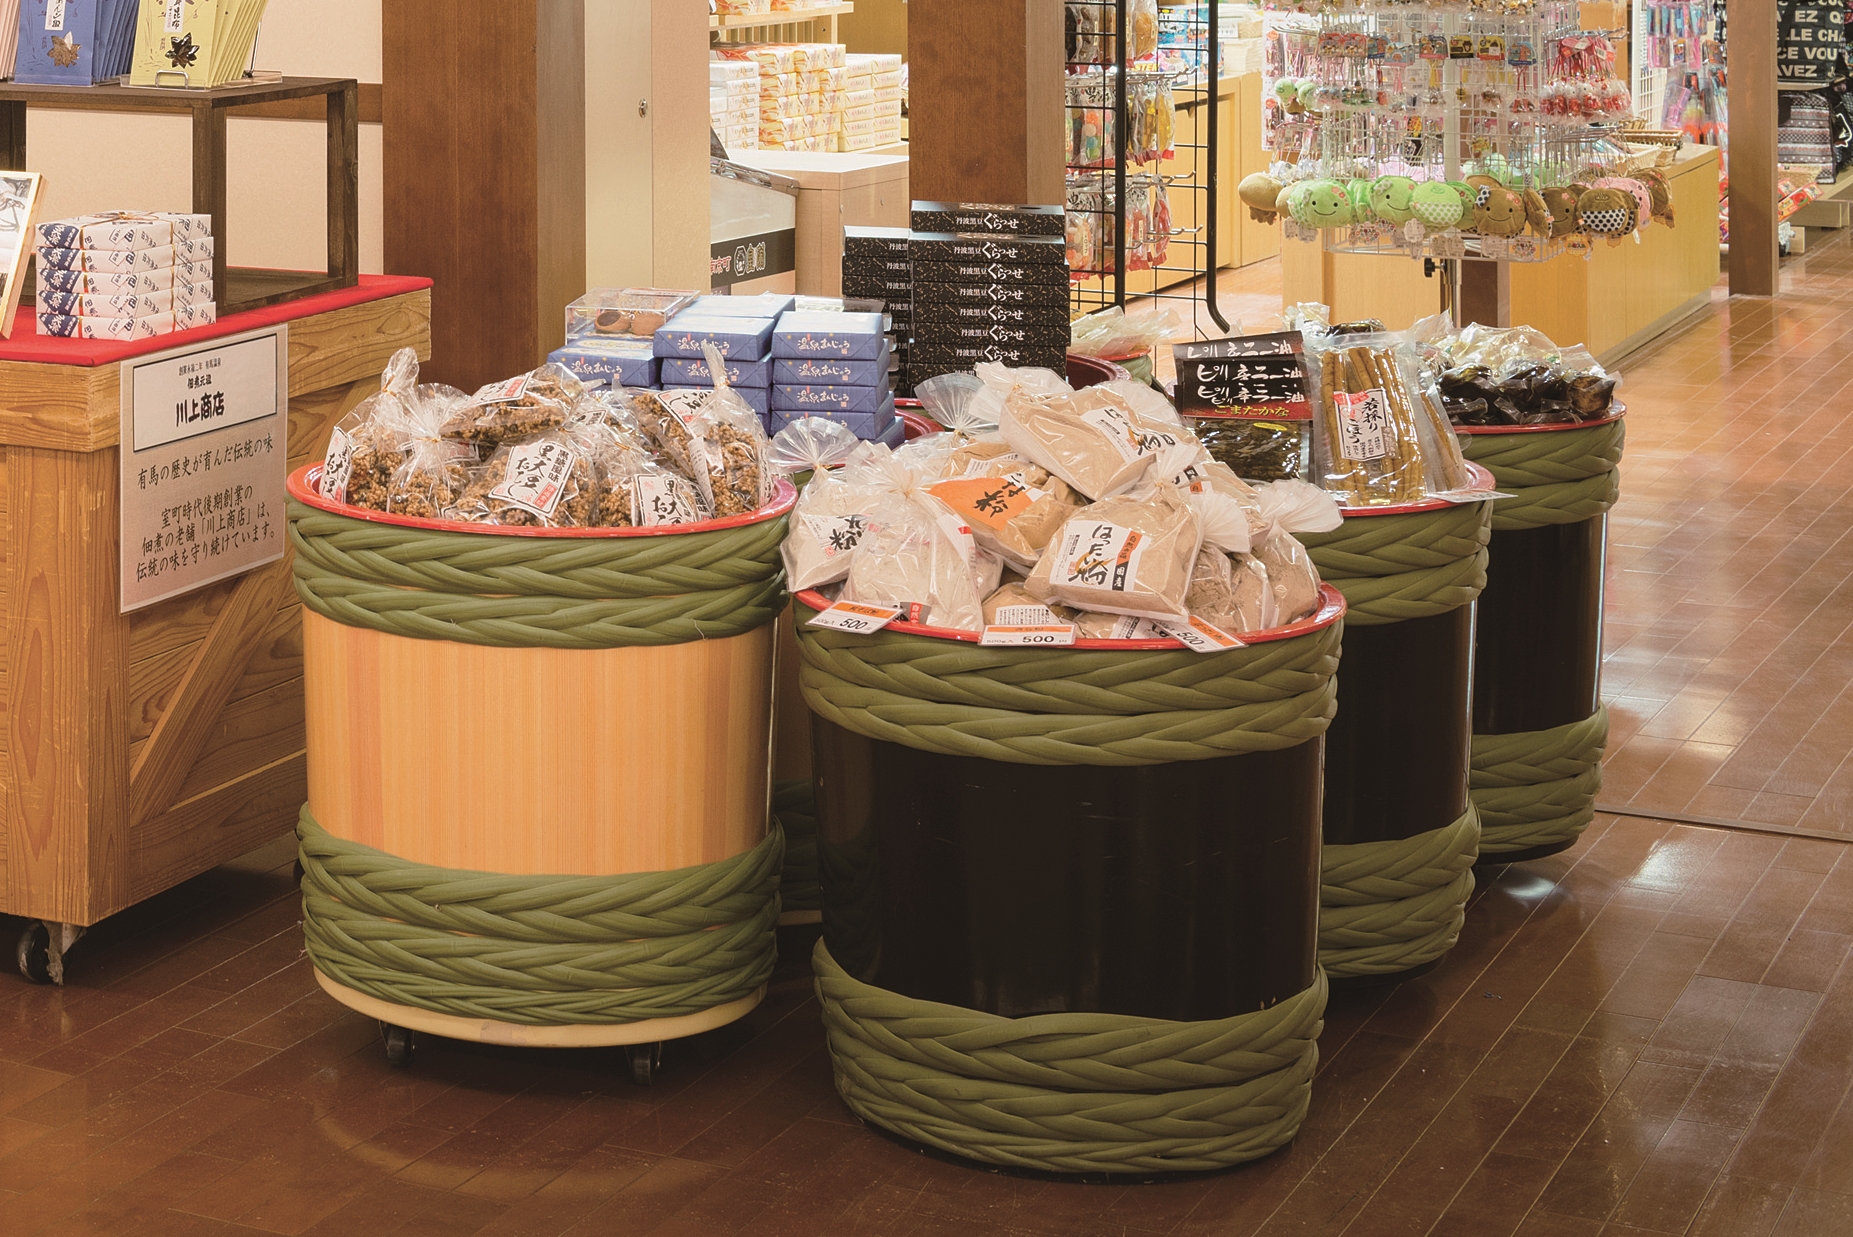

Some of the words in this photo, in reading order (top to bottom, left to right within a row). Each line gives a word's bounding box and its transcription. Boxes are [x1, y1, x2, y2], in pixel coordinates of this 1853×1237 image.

[175, 391, 225, 428] 川上商店
[1214, 404, 1290, 417] ごまたかな
[136, 432, 274, 491] 有馬の歴史が育んだ伝統の味
[161, 484, 254, 529] 室町時代後期創業の
[135, 521, 276, 583] 伝統の味を守り続けています。
[1068, 524, 1113, 586] はったい粉
[839, 618, 867, 629] 500
[1022, 635, 1055, 643] 500
[1177, 632, 1205, 646] 500
